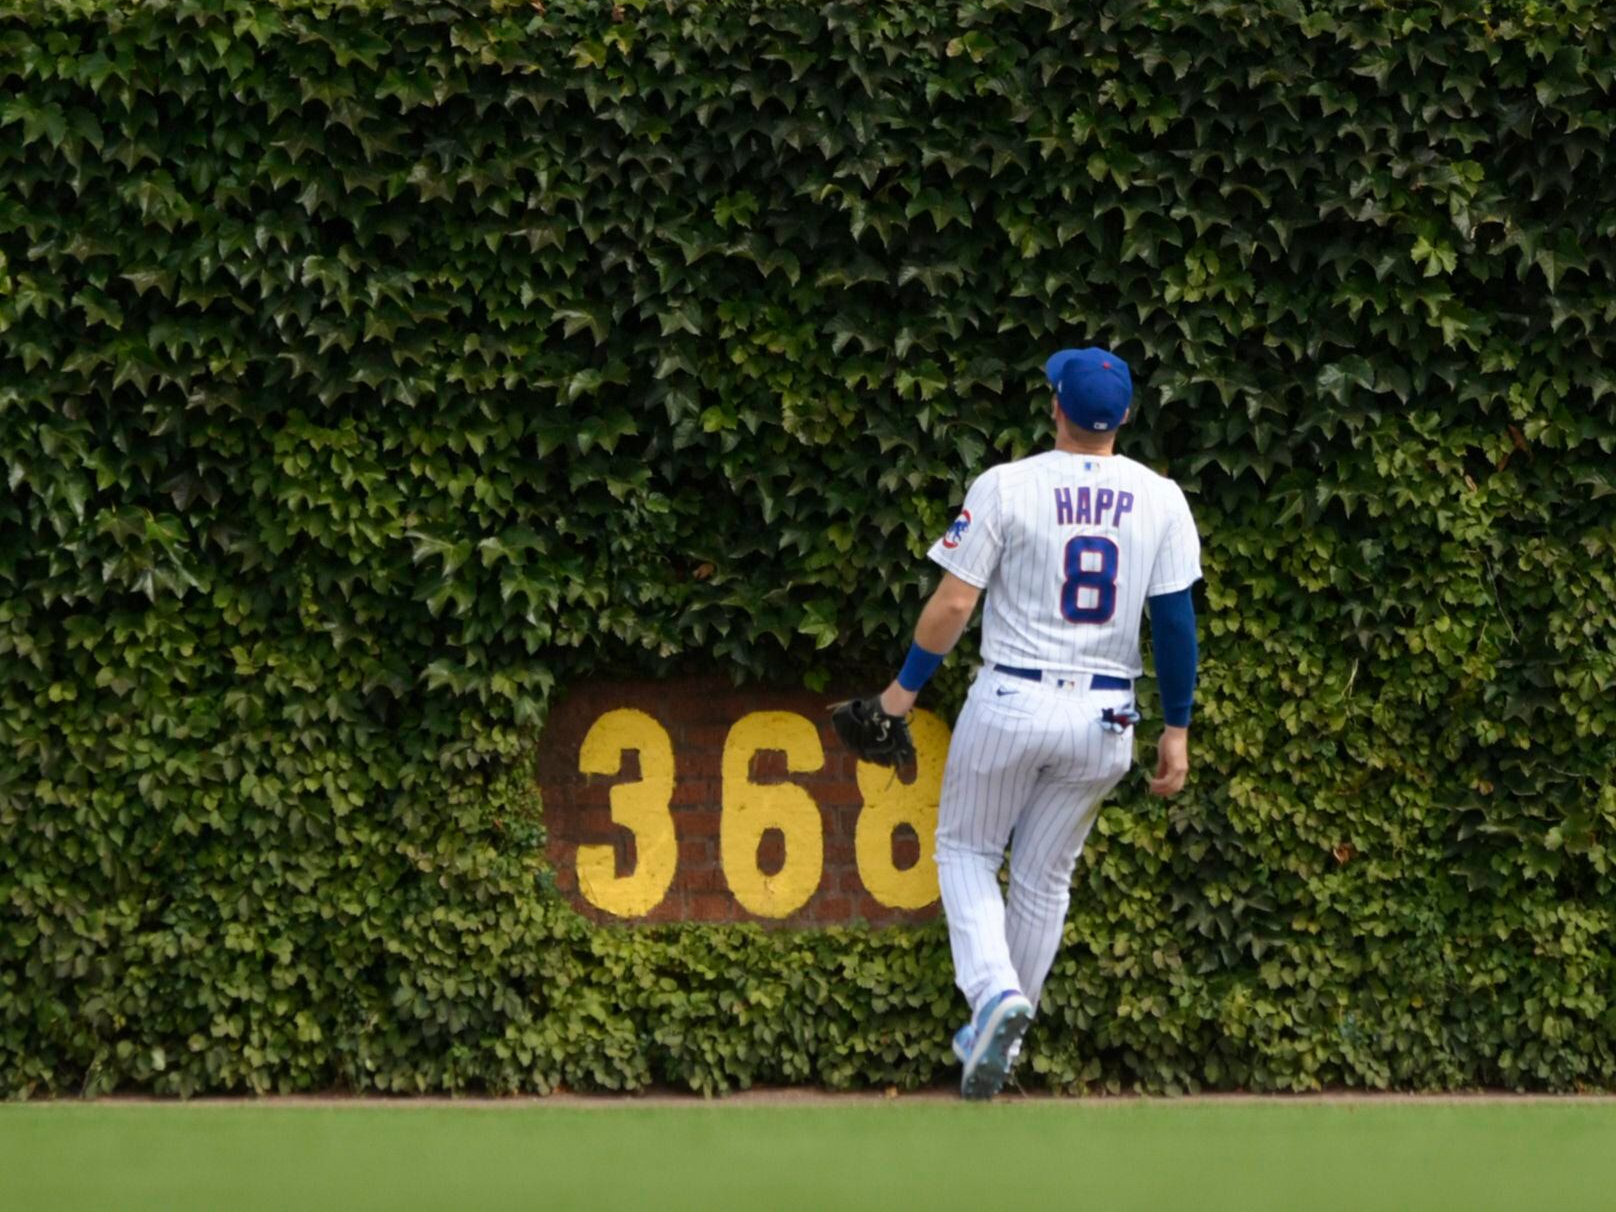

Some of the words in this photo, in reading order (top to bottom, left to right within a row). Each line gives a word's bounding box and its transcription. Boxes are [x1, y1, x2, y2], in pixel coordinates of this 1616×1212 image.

[1054, 487, 1134, 527] HAPP
[1060, 536, 1119, 624] 8
[577, 707, 951, 919] 368
